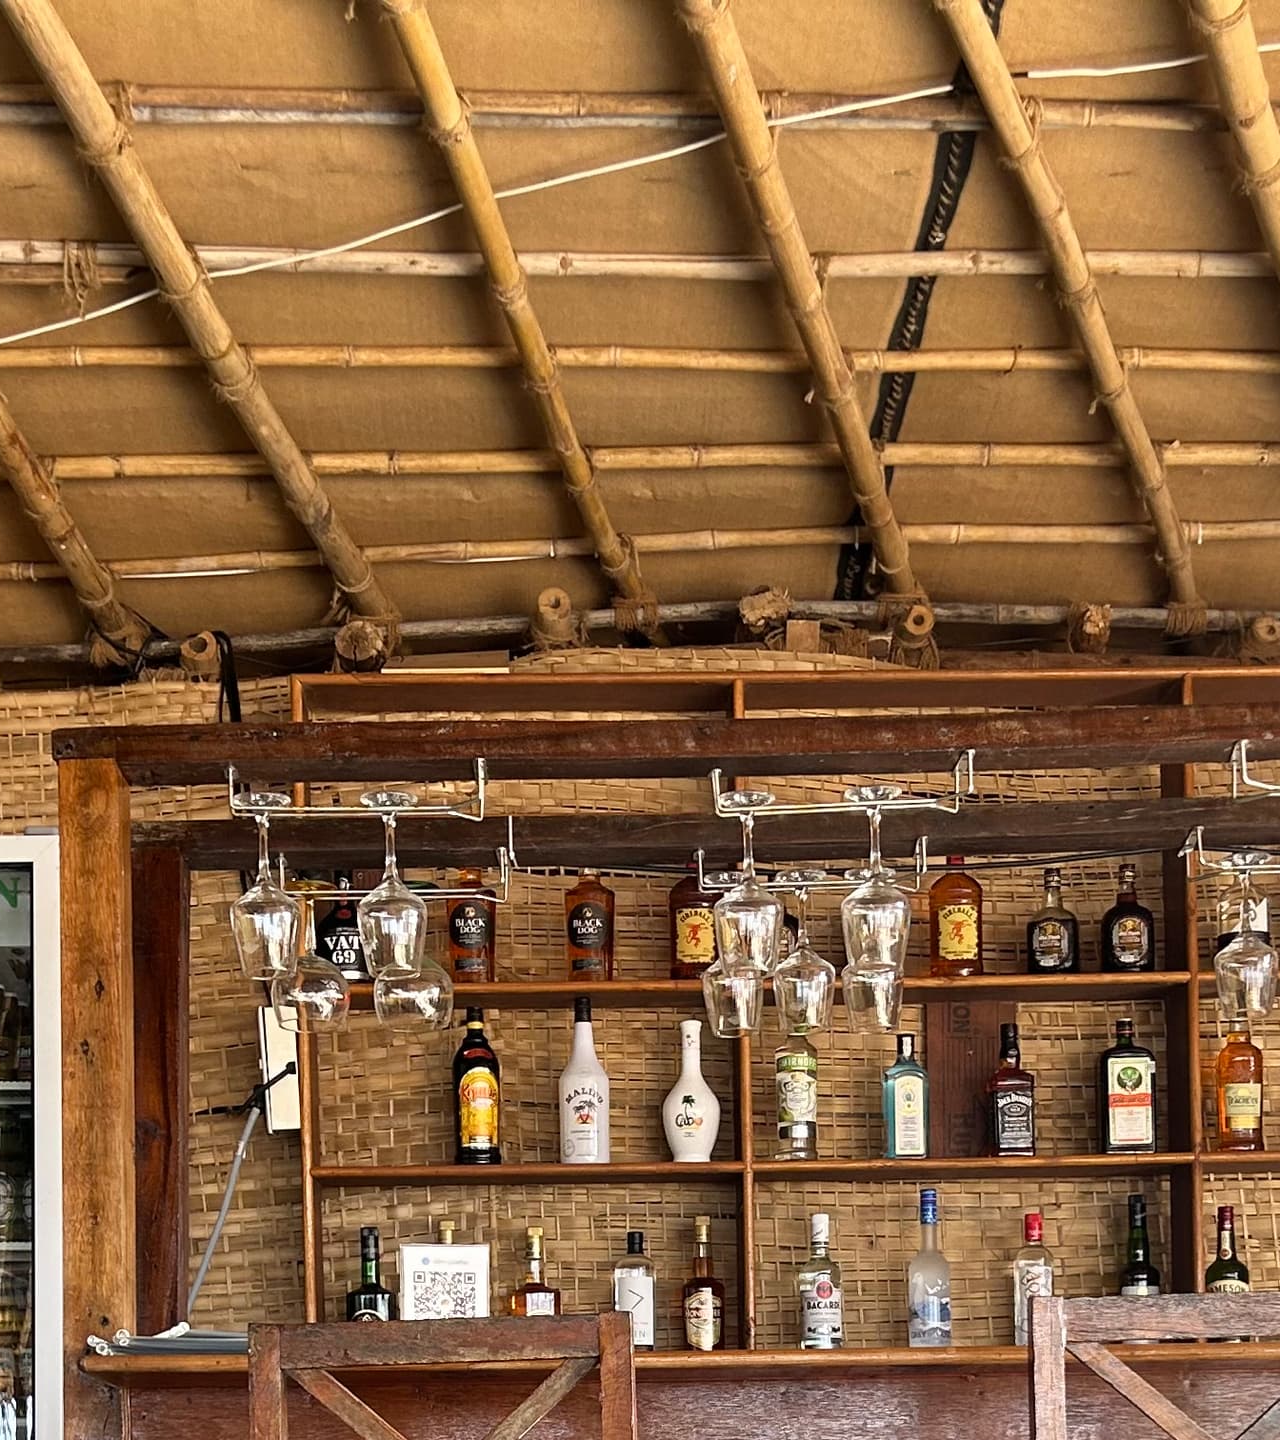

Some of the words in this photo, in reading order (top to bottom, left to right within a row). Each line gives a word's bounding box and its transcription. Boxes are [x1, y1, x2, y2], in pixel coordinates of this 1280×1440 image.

[455, 918, 486, 928] BLACK
[573, 919, 603, 928] BLACK
[460, 926, 481, 934] DOG
[324, 936, 361, 951] VAT
[332, 950, 356, 964] 69
[806, 1301, 841, 1310] BACARDI
[634, 1329, 646, 1338] IN
